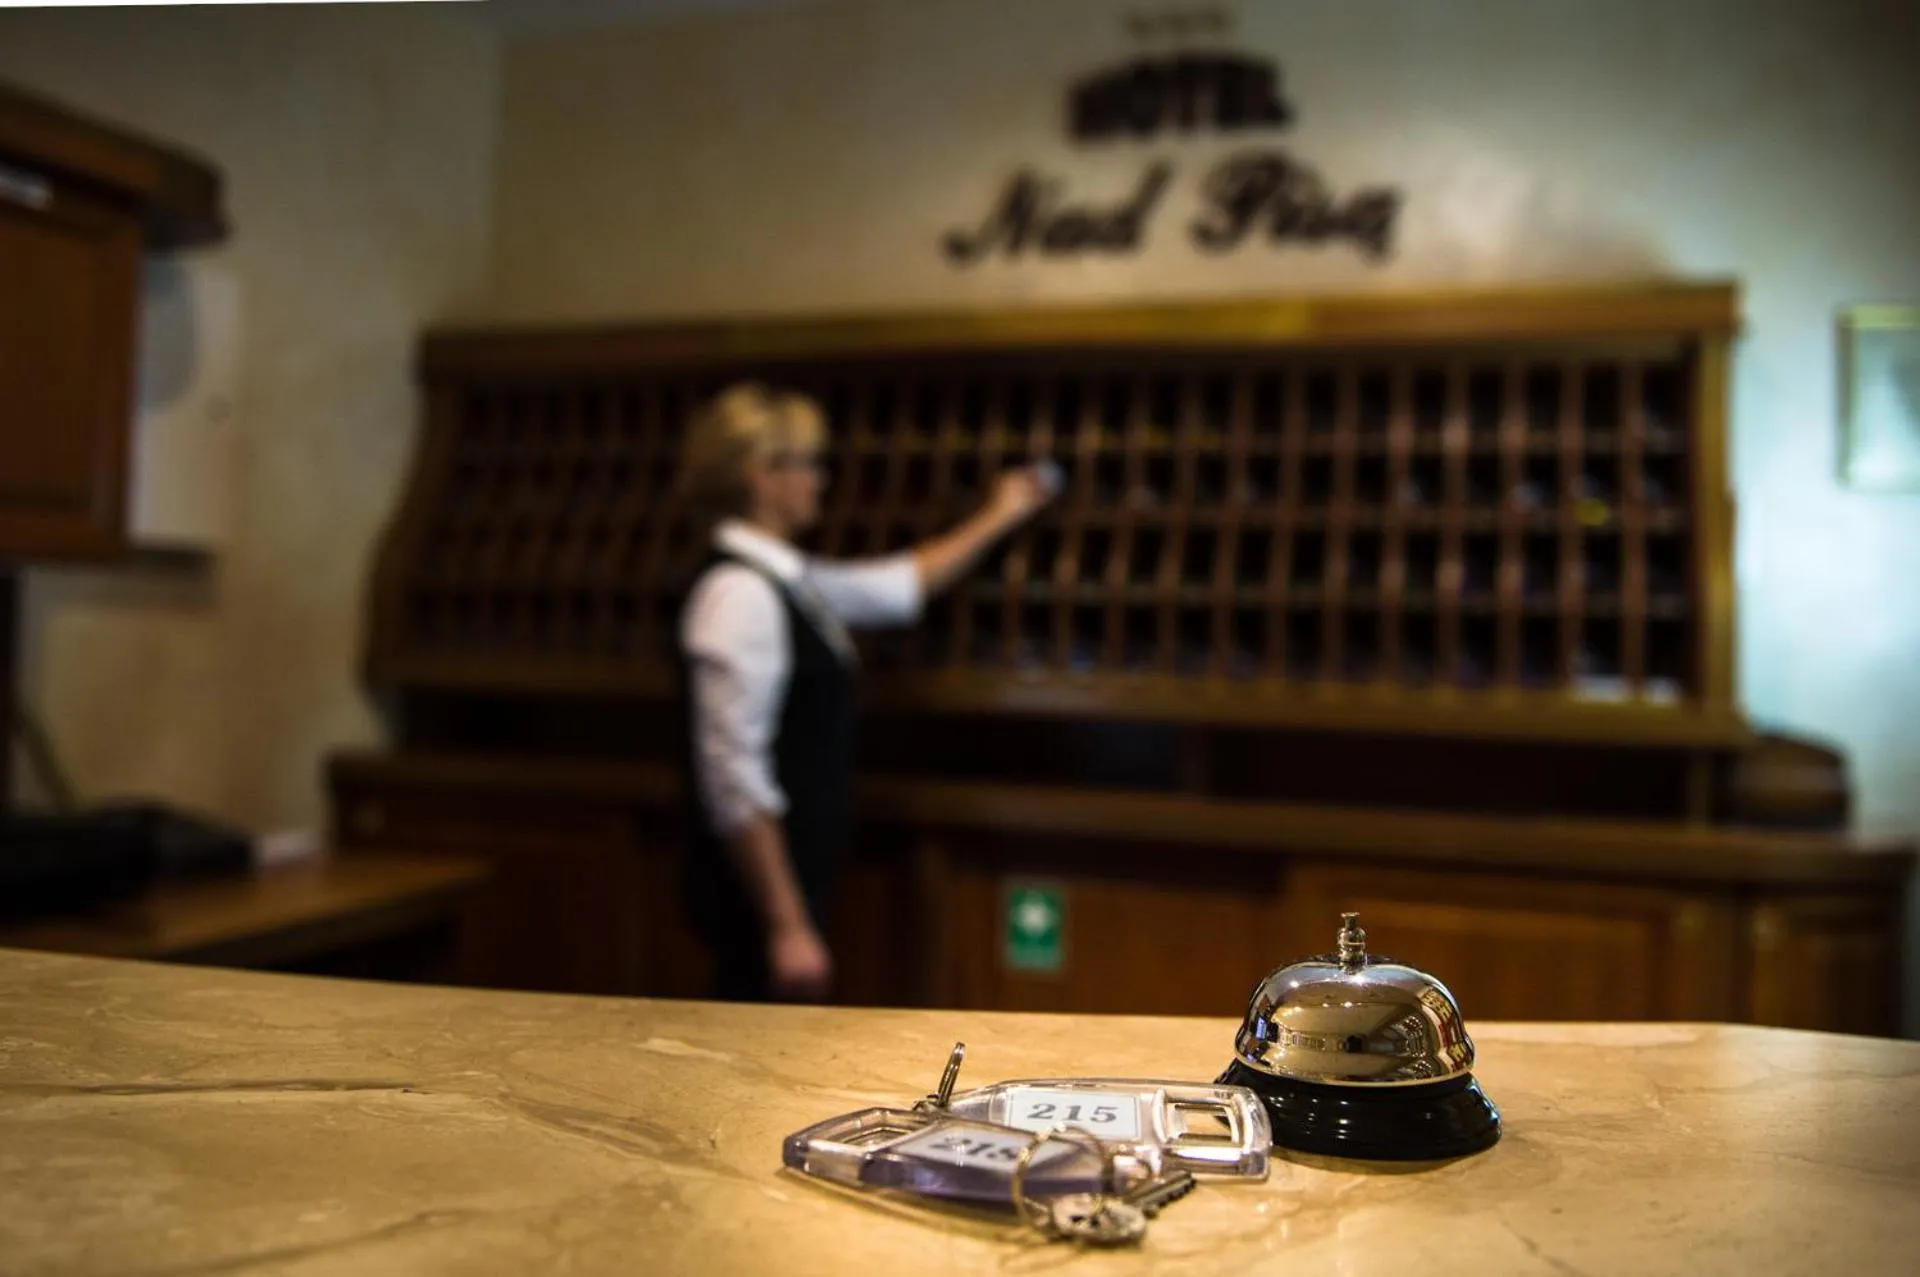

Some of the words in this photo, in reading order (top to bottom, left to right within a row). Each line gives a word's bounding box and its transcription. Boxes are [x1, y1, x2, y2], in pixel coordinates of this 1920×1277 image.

[1067, 52, 1291, 145] HOTEL
[944, 160, 1173, 264] Nad
[1026, 1102, 1119, 1123] 215
